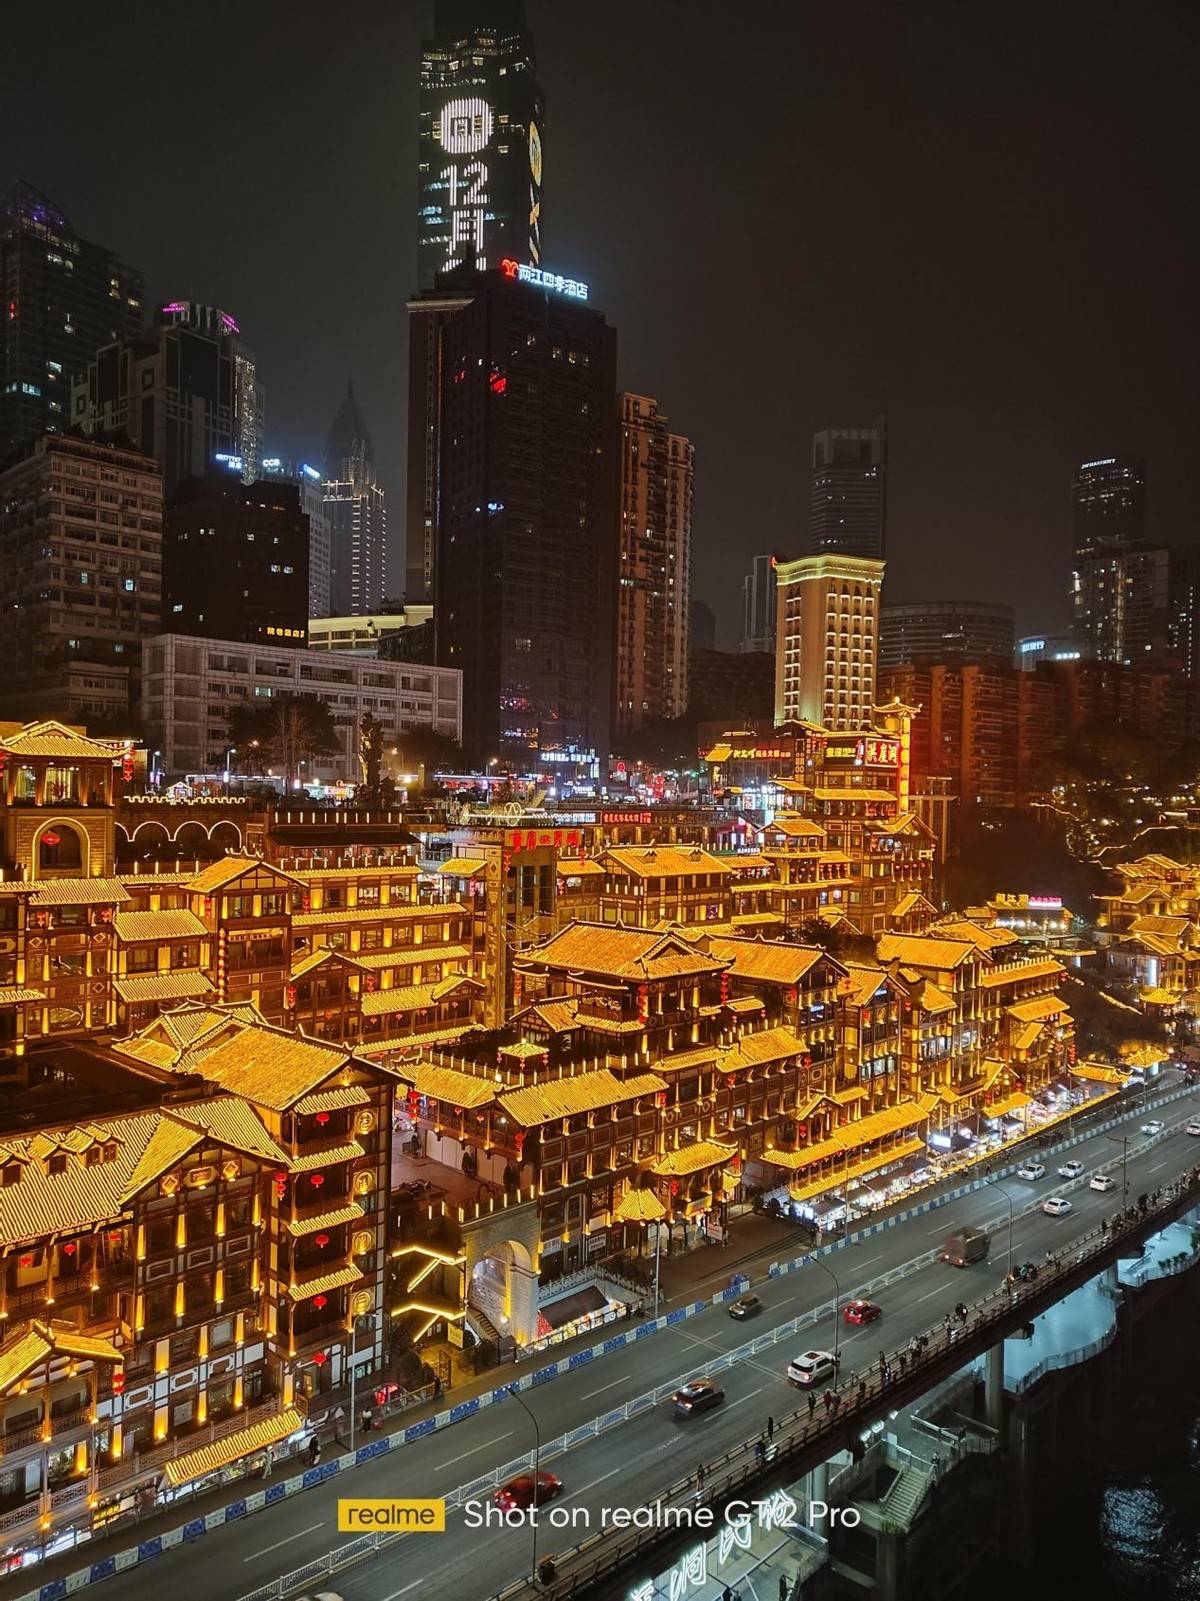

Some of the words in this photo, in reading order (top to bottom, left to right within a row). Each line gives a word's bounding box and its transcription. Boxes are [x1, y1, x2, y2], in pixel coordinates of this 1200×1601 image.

[518, 264, 588, 300] 两江四季酒店
[866, 742, 898, 764] 洪崖洞
